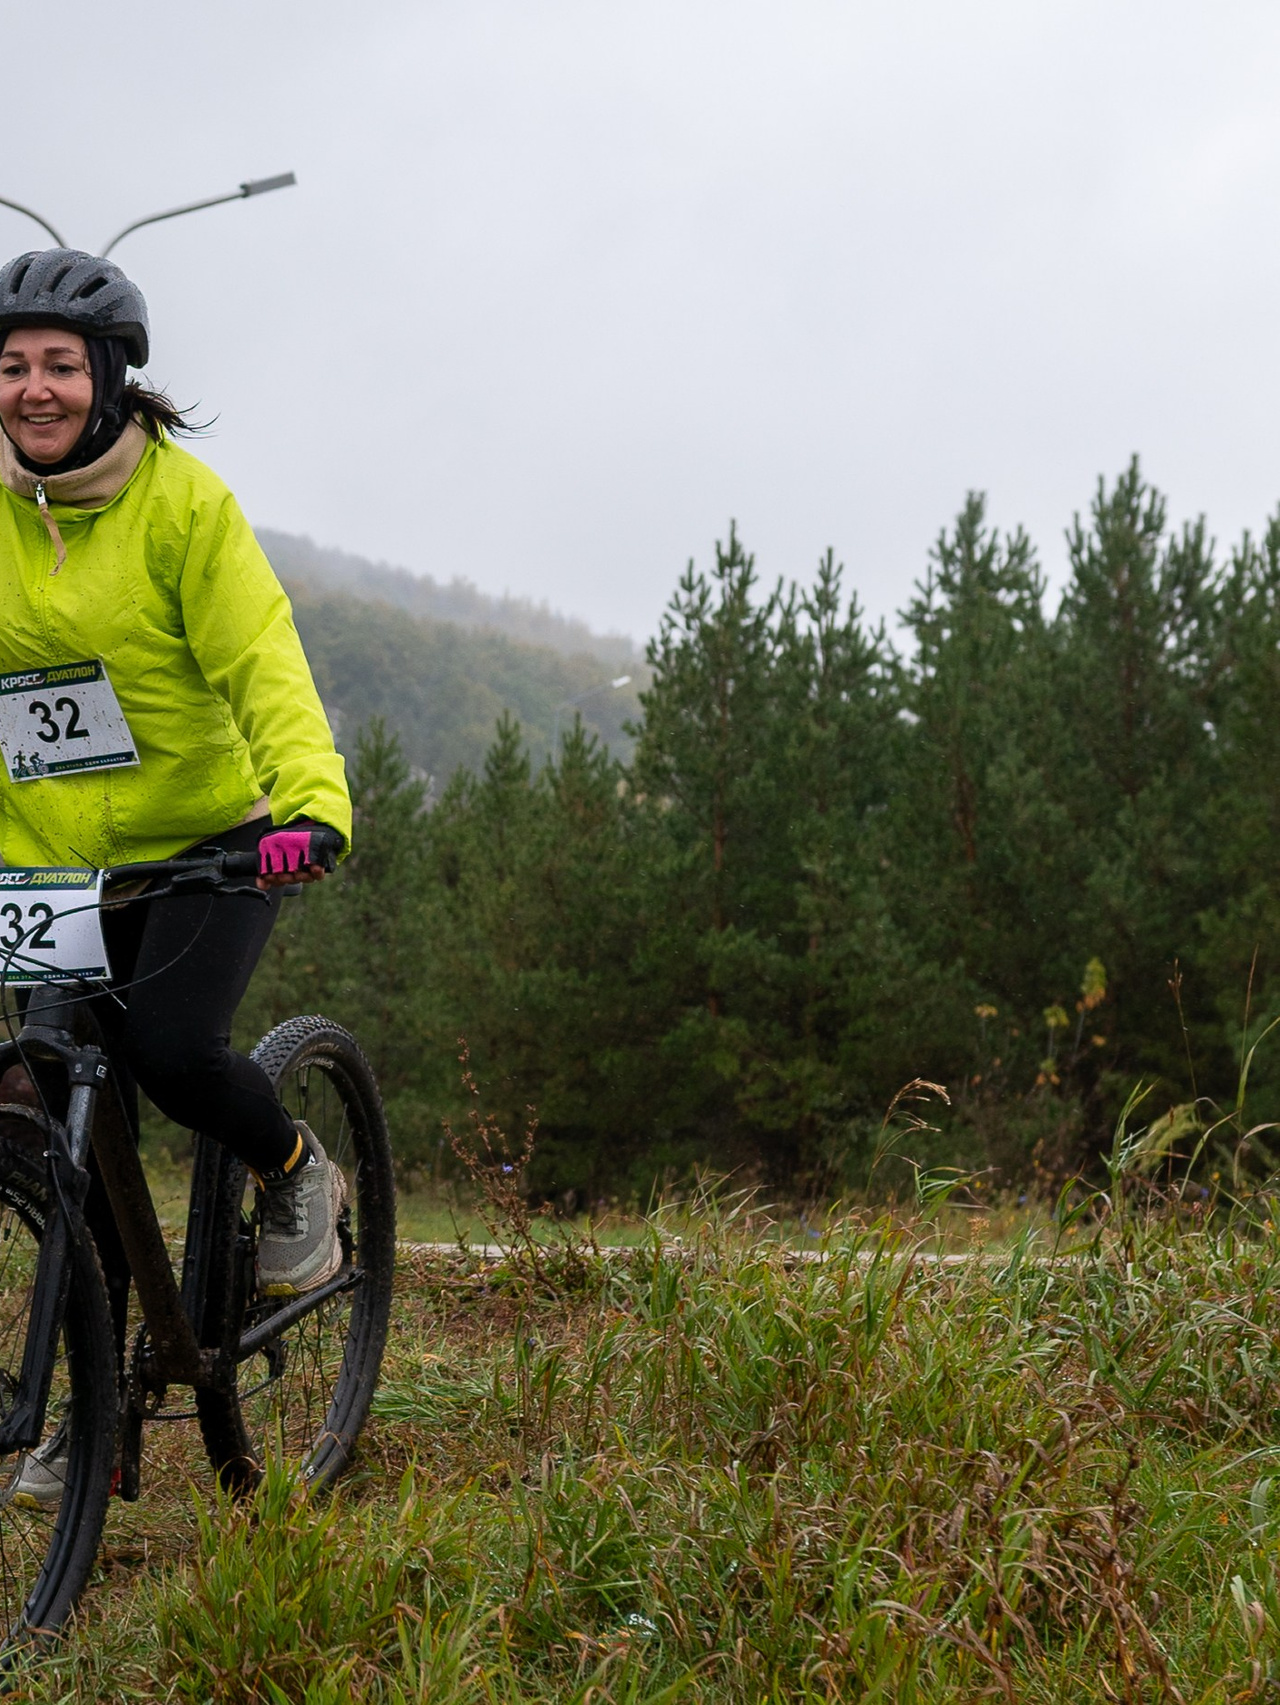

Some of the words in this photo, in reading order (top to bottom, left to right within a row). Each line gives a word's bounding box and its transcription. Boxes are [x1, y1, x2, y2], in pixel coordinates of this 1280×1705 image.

[46, 665, 96, 683] ДУАТЛОН
[29, 697, 90, 743] 32
[29, 872, 92, 885] ДУАТЛОН
[0, 902, 56, 949] 32
